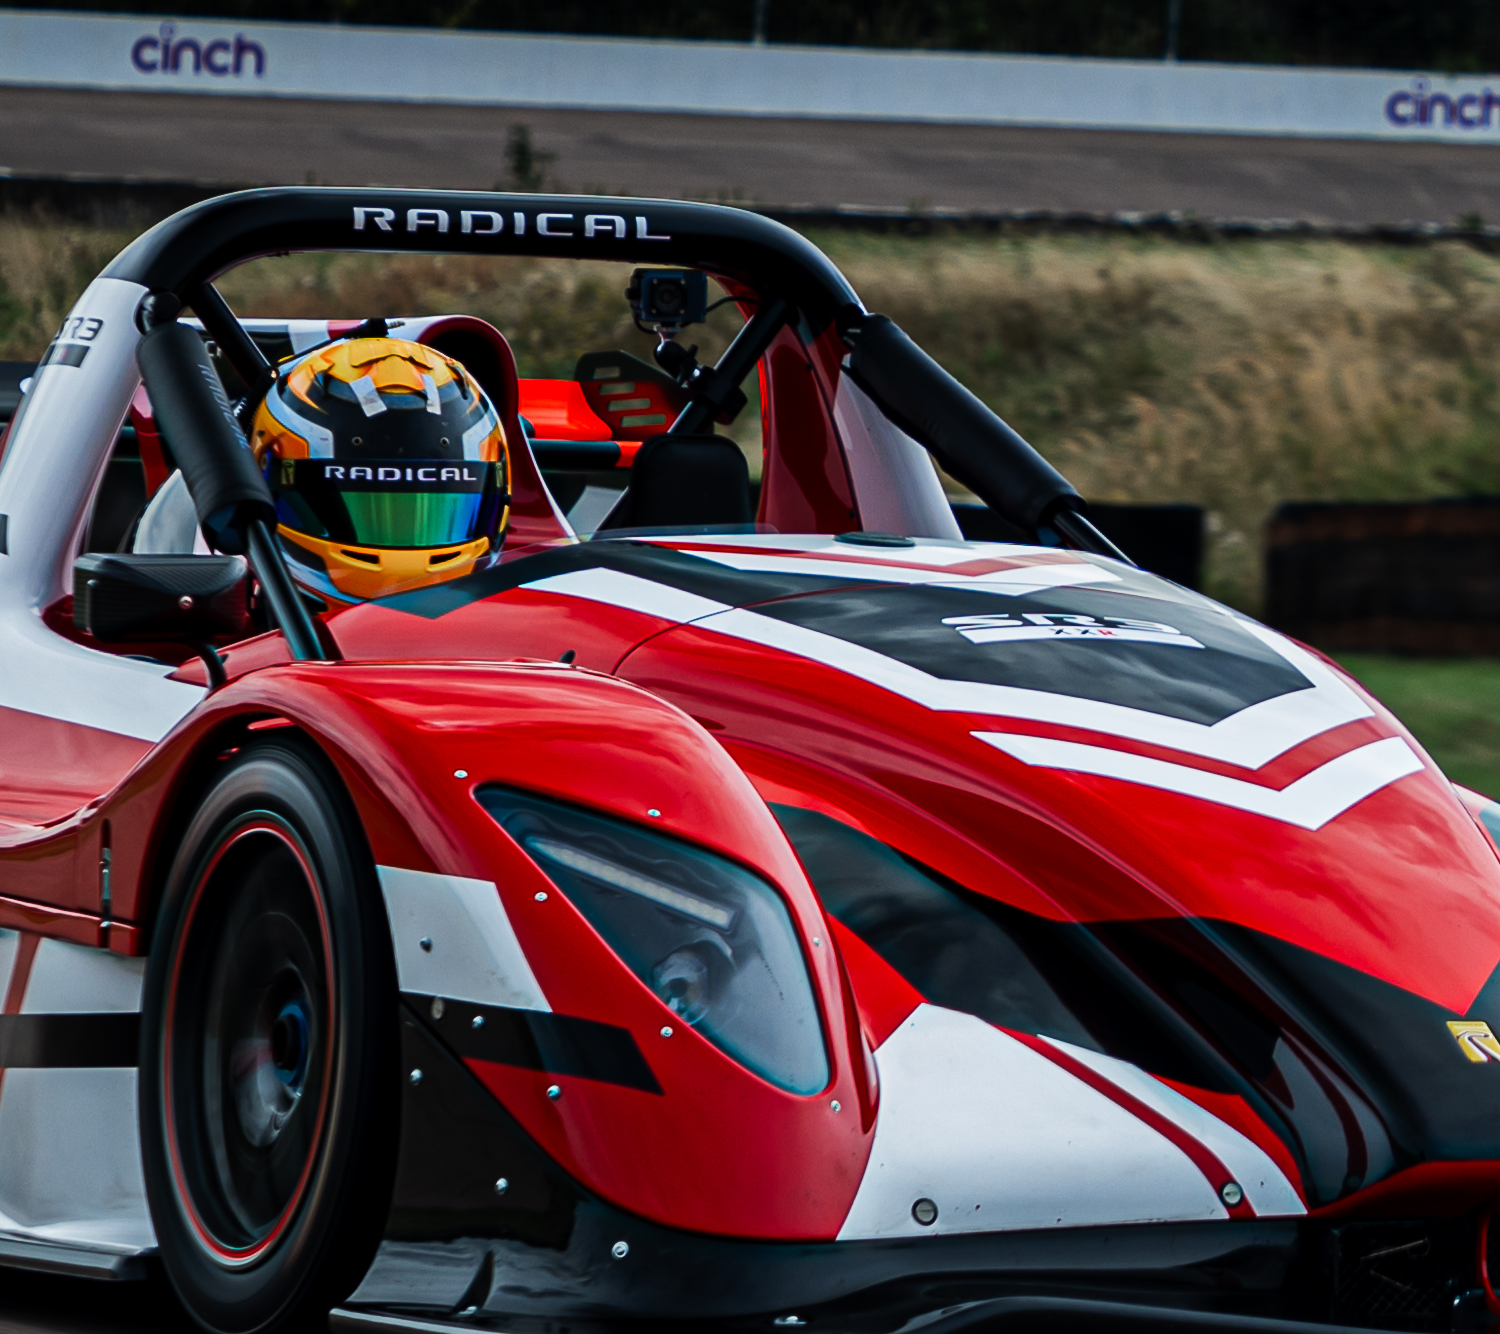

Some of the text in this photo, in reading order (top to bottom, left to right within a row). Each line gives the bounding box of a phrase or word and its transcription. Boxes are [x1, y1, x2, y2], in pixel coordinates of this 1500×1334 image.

[130, 20, 266, 78] cinch
[353, 207, 671, 239] RADICAL
[324, 465, 477, 481] RADICAL
[940, 612, 1182, 635] SR3
